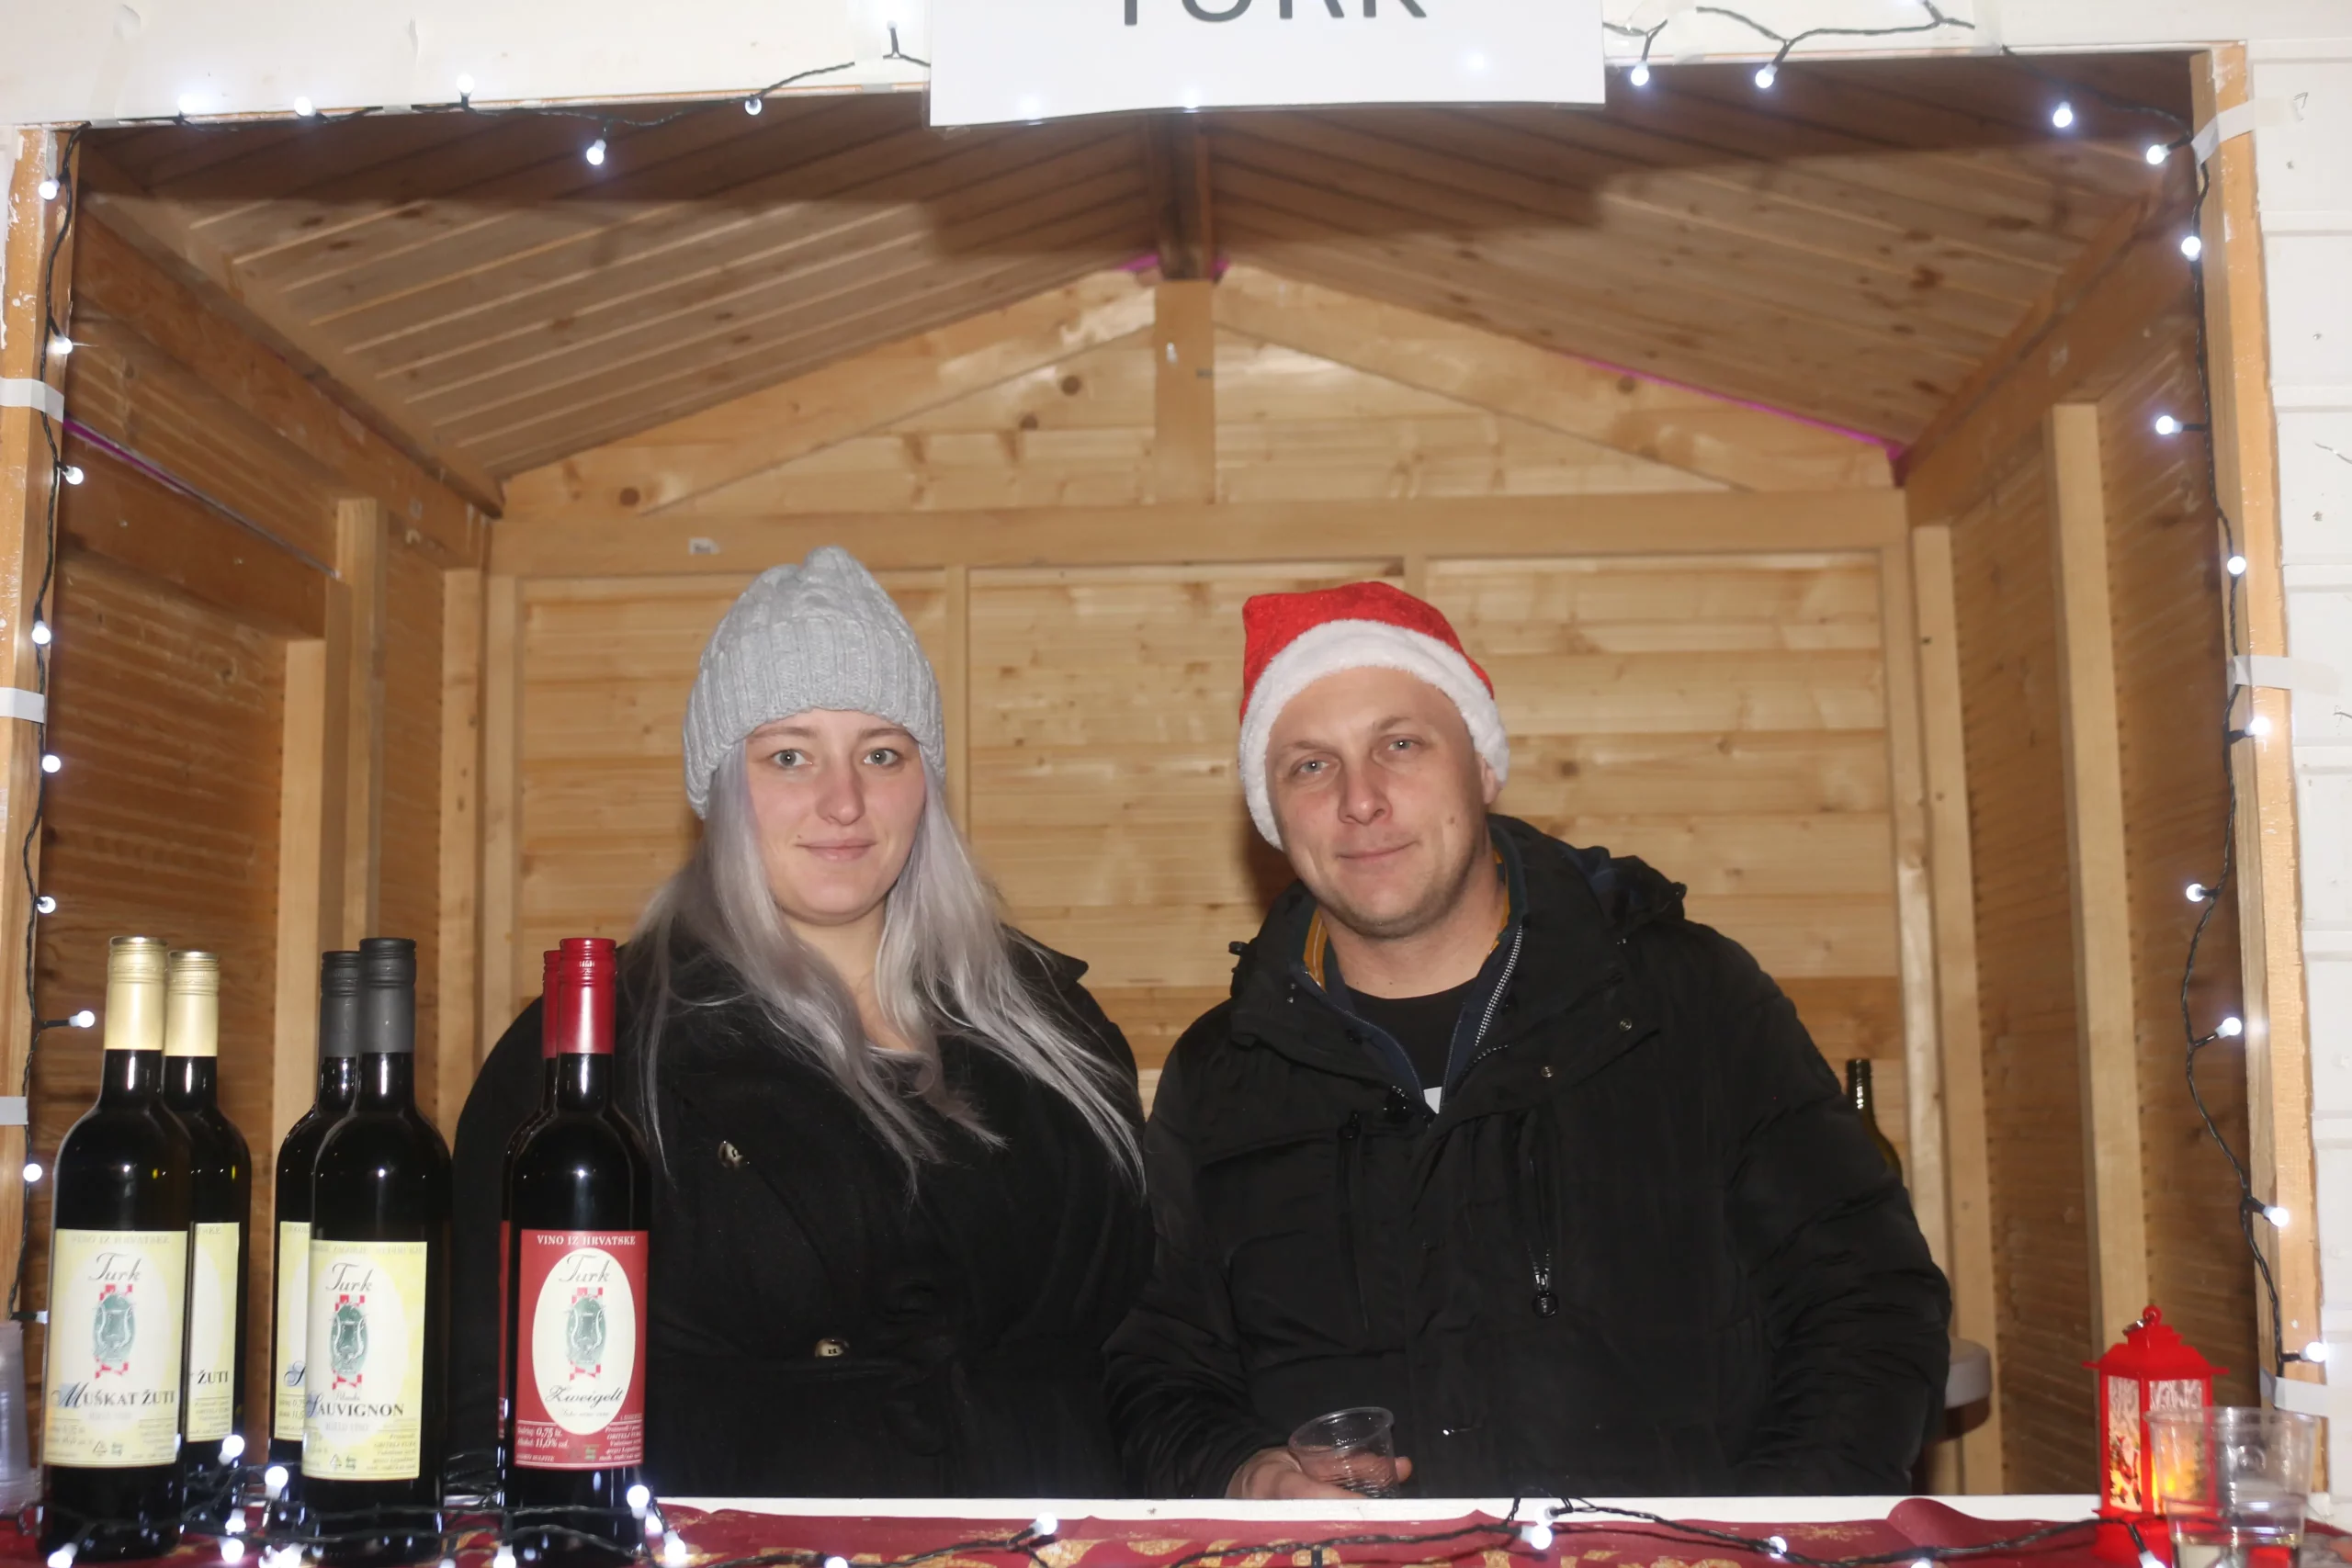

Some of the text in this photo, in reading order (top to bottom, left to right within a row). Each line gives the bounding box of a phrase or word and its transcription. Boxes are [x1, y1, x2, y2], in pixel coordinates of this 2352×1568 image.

[537, 1235, 637, 1246] VINO IZ HRVATSKE
[88, 1252, 142, 1281] Turk
[325, 1262, 373, 1292] Turk
[559, 1254, 610, 1282] Turk
[197, 1370, 229, 1384] ŽUTI
[141, 1389, 176, 1405] ŽUTI
